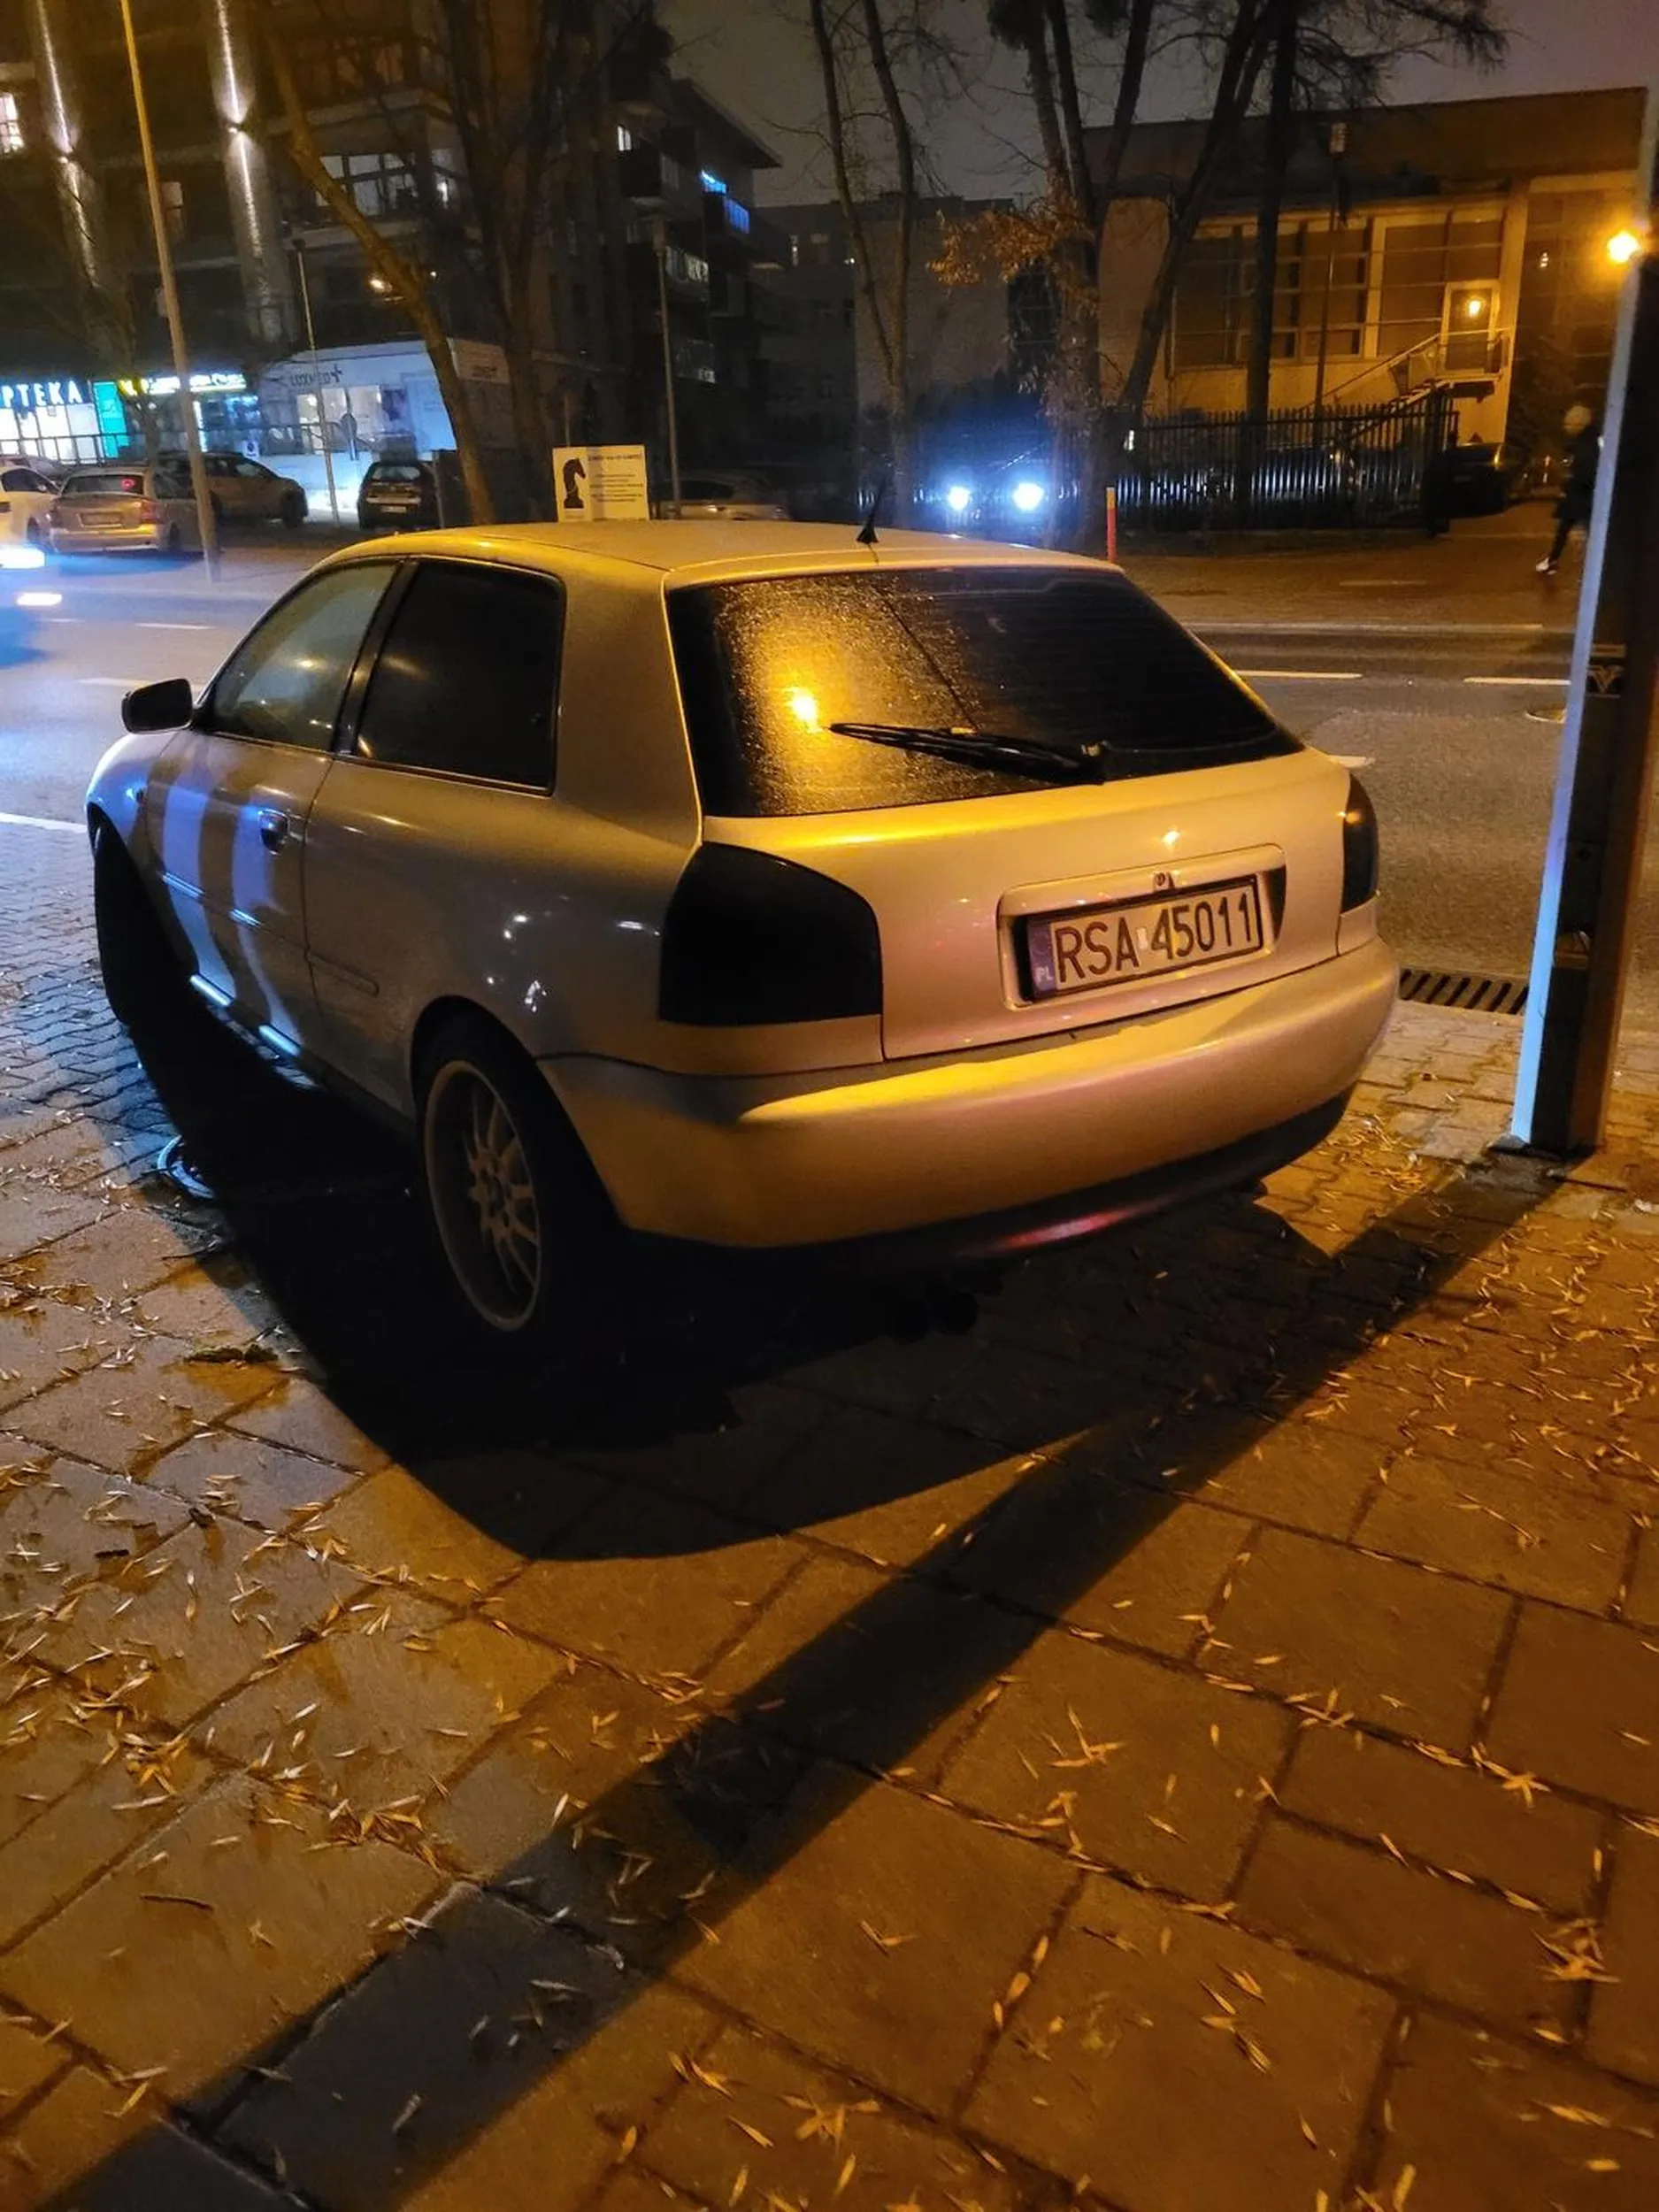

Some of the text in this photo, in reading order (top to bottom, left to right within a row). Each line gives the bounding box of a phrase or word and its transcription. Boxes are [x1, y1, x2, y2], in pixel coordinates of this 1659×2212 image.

[1054, 893, 1251, 983] RSA 45011
[1036, 965, 1054, 985] PL
